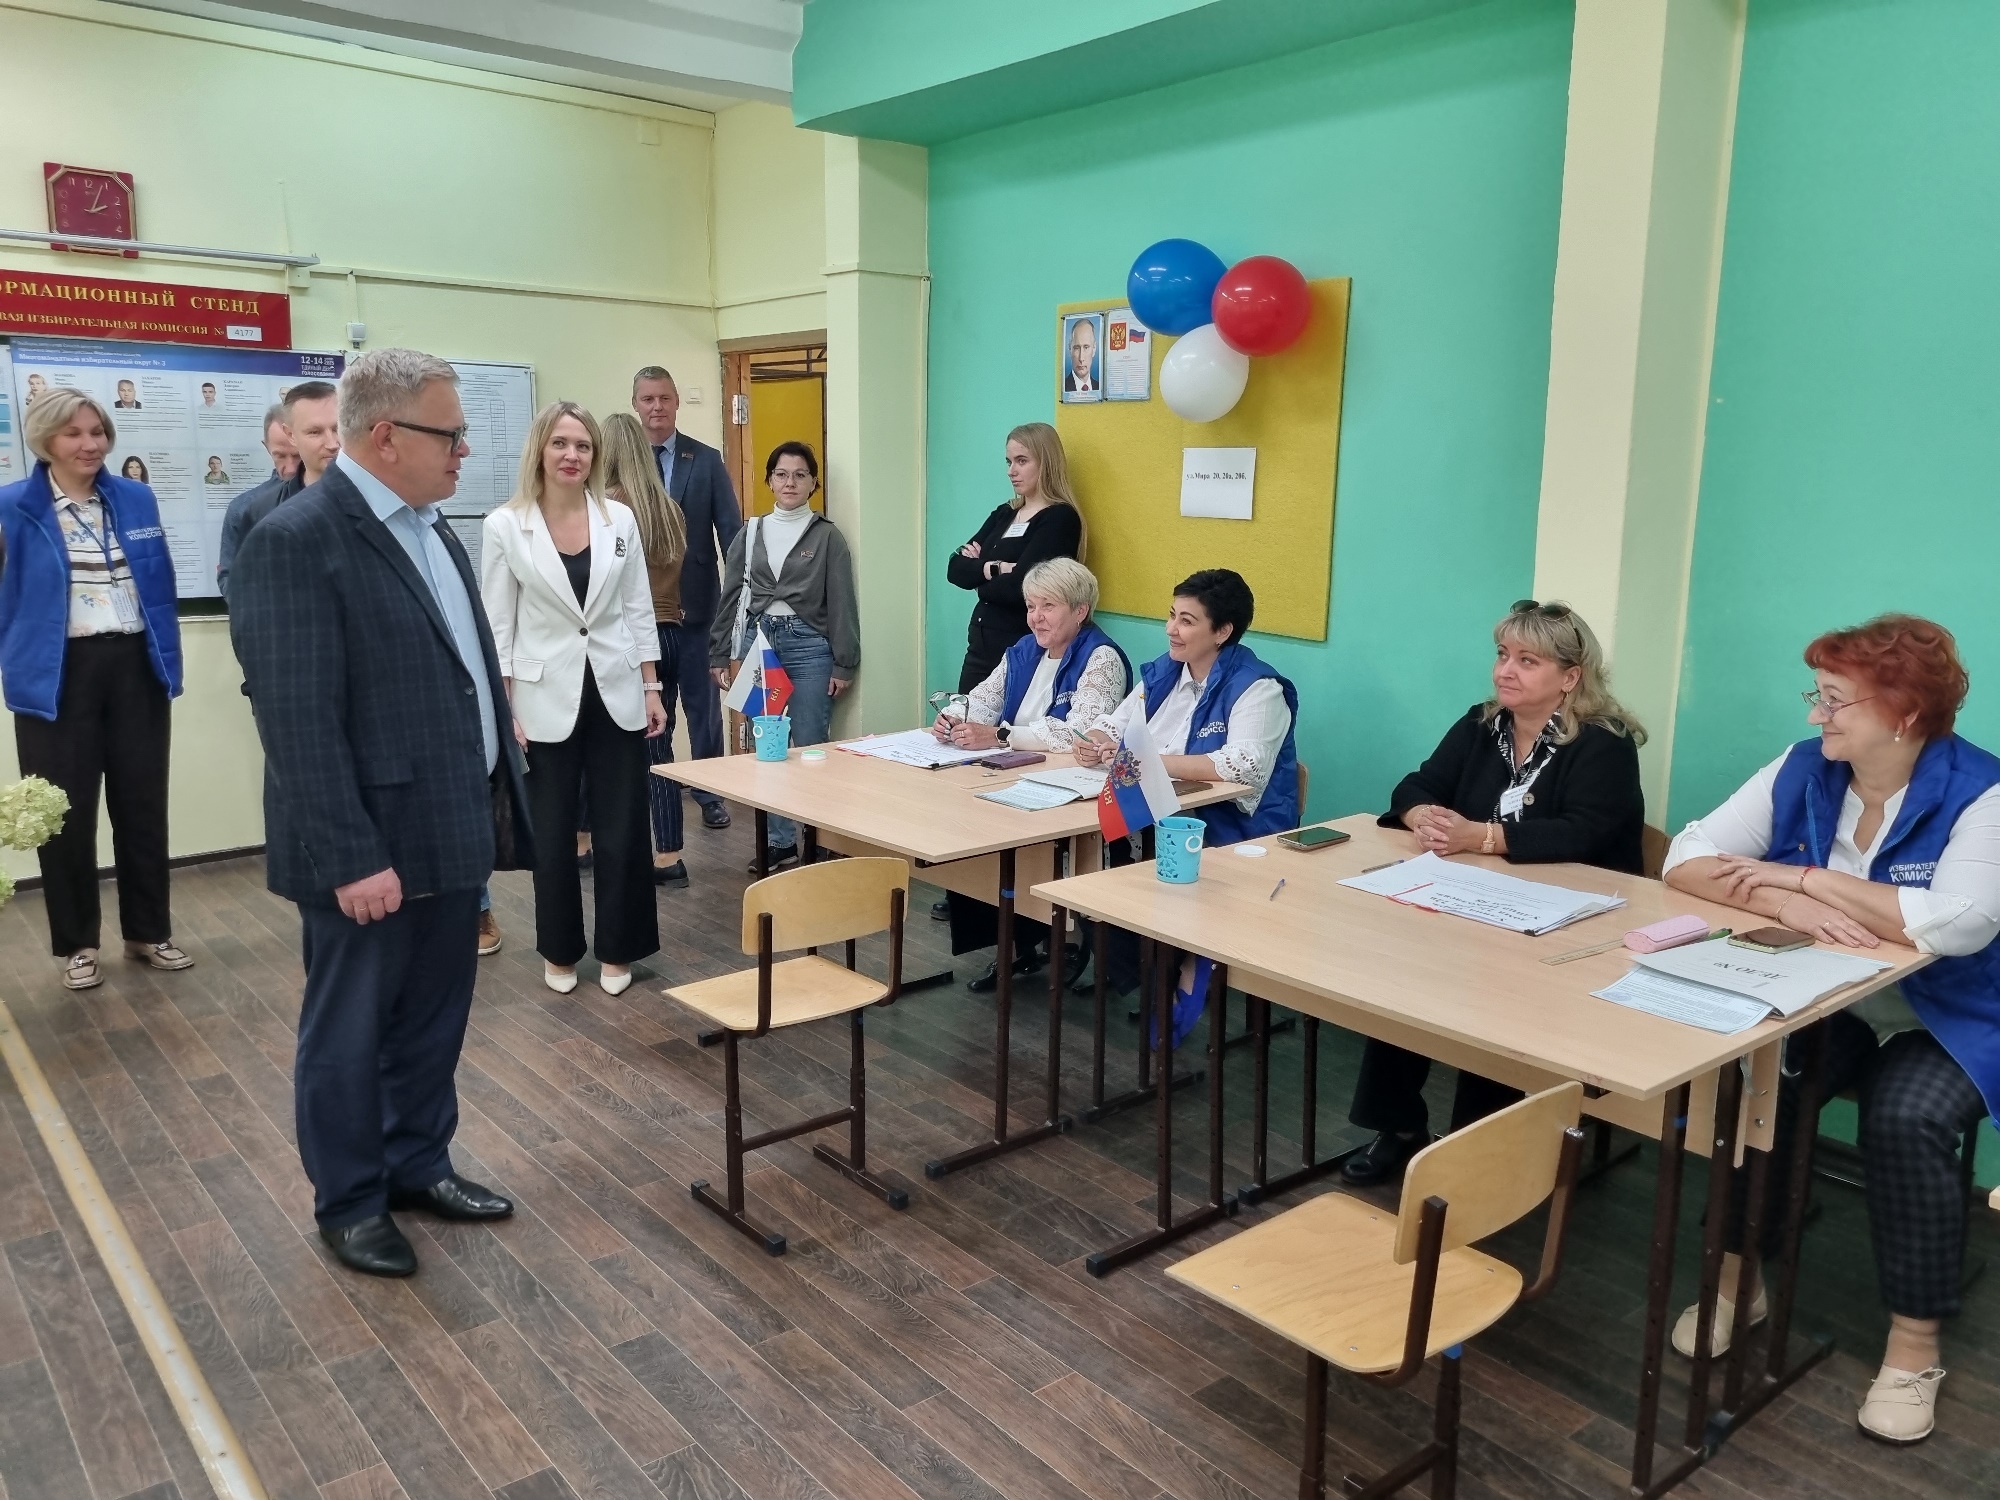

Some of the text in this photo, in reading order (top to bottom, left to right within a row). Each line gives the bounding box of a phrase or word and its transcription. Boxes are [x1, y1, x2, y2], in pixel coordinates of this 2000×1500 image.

[0, 280, 260, 316] РМАЦИОННЫЙ СТЕНД
[28, 313, 138, 330] ИЗБИРАТЕЛЬНАЯ
[141, 321, 208, 335] КОМИССИЯ
[234, 328, 254, 337] 4177
[300, 355, 323, 365] 12-14
